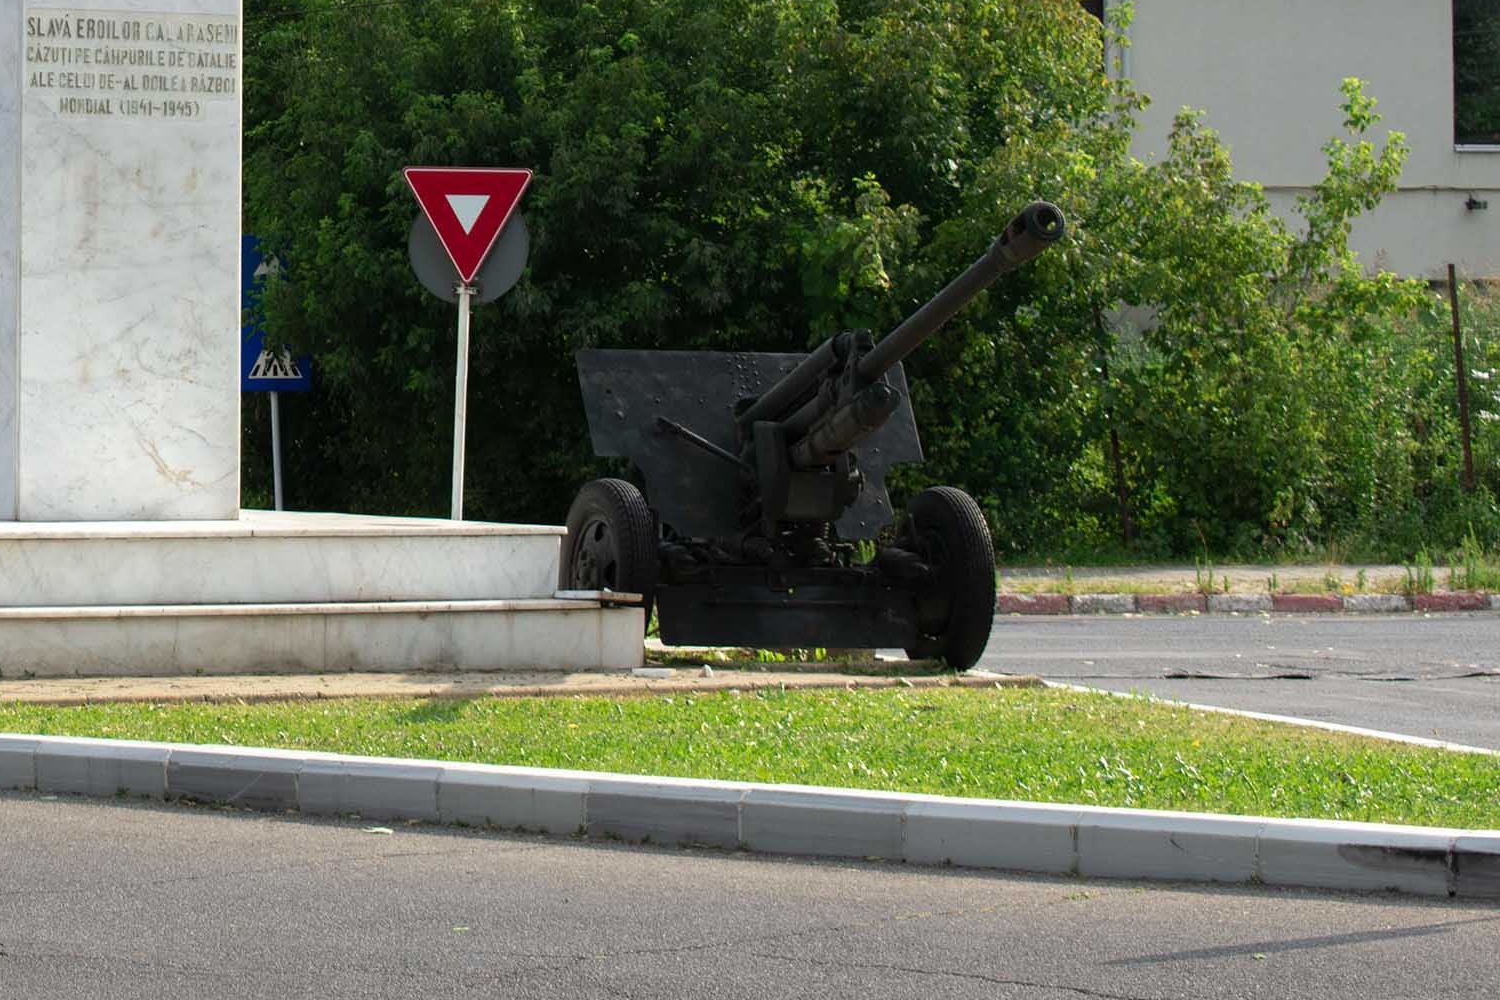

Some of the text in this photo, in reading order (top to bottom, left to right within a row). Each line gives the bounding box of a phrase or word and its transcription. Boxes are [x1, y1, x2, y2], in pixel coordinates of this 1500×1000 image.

[77, 18, 141, 41] EROILOR
[74, 47, 91, 64] PE
[168, 51, 185, 67] DE
[30, 72, 54, 88] ALE
[59, 73, 95, 89] CELUI
[99, 75, 139, 91] DE-AL
[142, 75, 187, 93] DOILEA
[59, 97, 113, 115] MONDIAL
